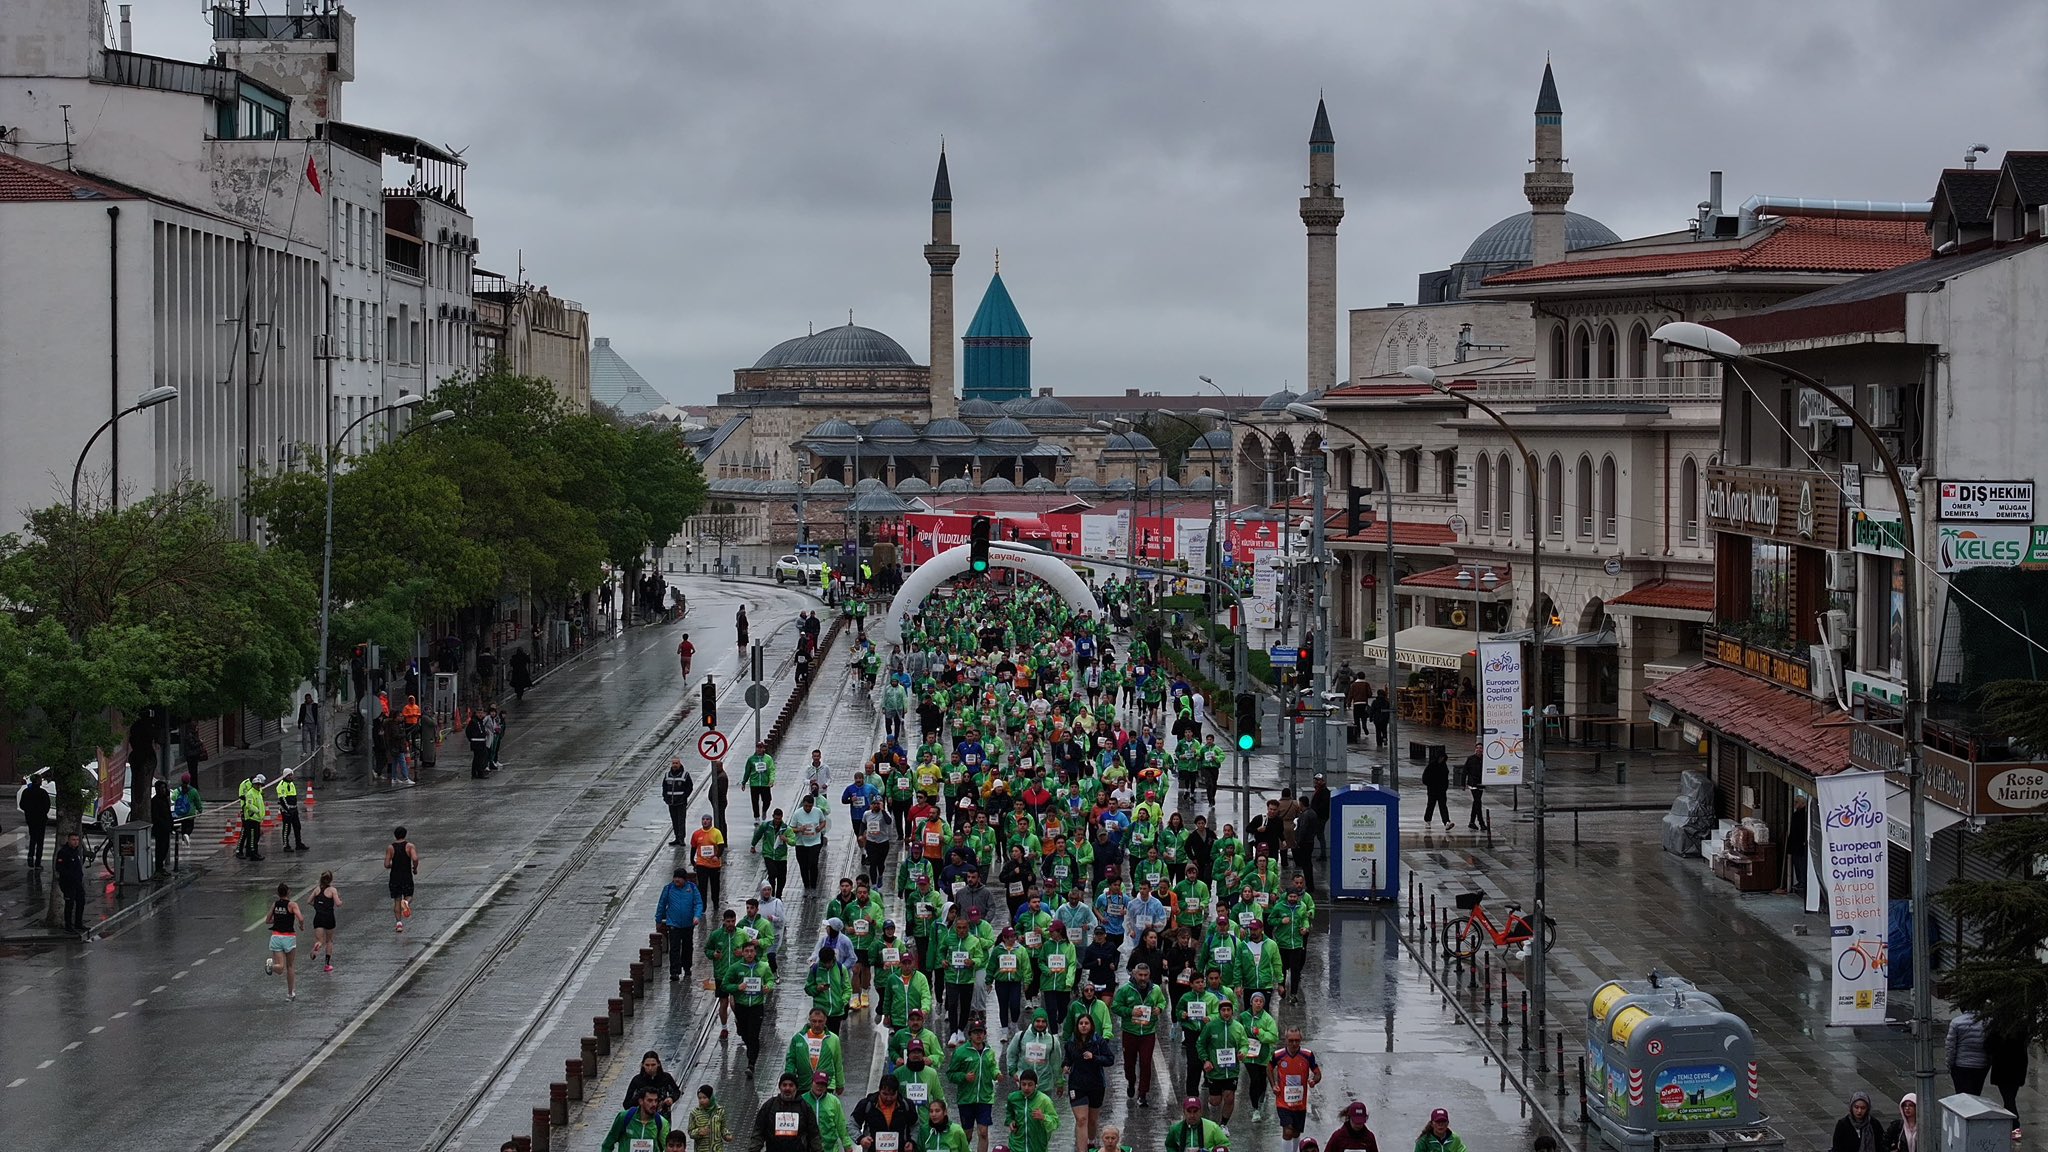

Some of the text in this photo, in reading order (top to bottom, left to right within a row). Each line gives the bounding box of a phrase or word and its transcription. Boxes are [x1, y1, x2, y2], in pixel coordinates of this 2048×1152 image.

[1989, 485, 2030, 499] HEKİMİ
[1705, 480, 1779, 535] Nezih Konya Mutfağı
[1858, 519, 1882, 551] KELEŞ
[1955, 540, 2020, 565] KELEŞ
[1395, 651, 1416, 663] ONYA
[1417, 656, 1456, 668] MUTFAĞI
[1486, 679, 1519, 687] European
[1852, 729, 1872, 762] ROSE
[1926, 773, 1933, 787] &
[1933, 764, 1946, 794] Gift
[1945, 769, 1966, 806] Shop
[2006, 773, 2043, 787] Rose
[1829, 841, 1882, 853] European
[1831, 852, 1883, 867] Capital of
[1832, 868, 1874, 881] Cycling
[1833, 882, 1875, 895] Avrupa
[1835, 895, 1876, 907] Bisiklet
